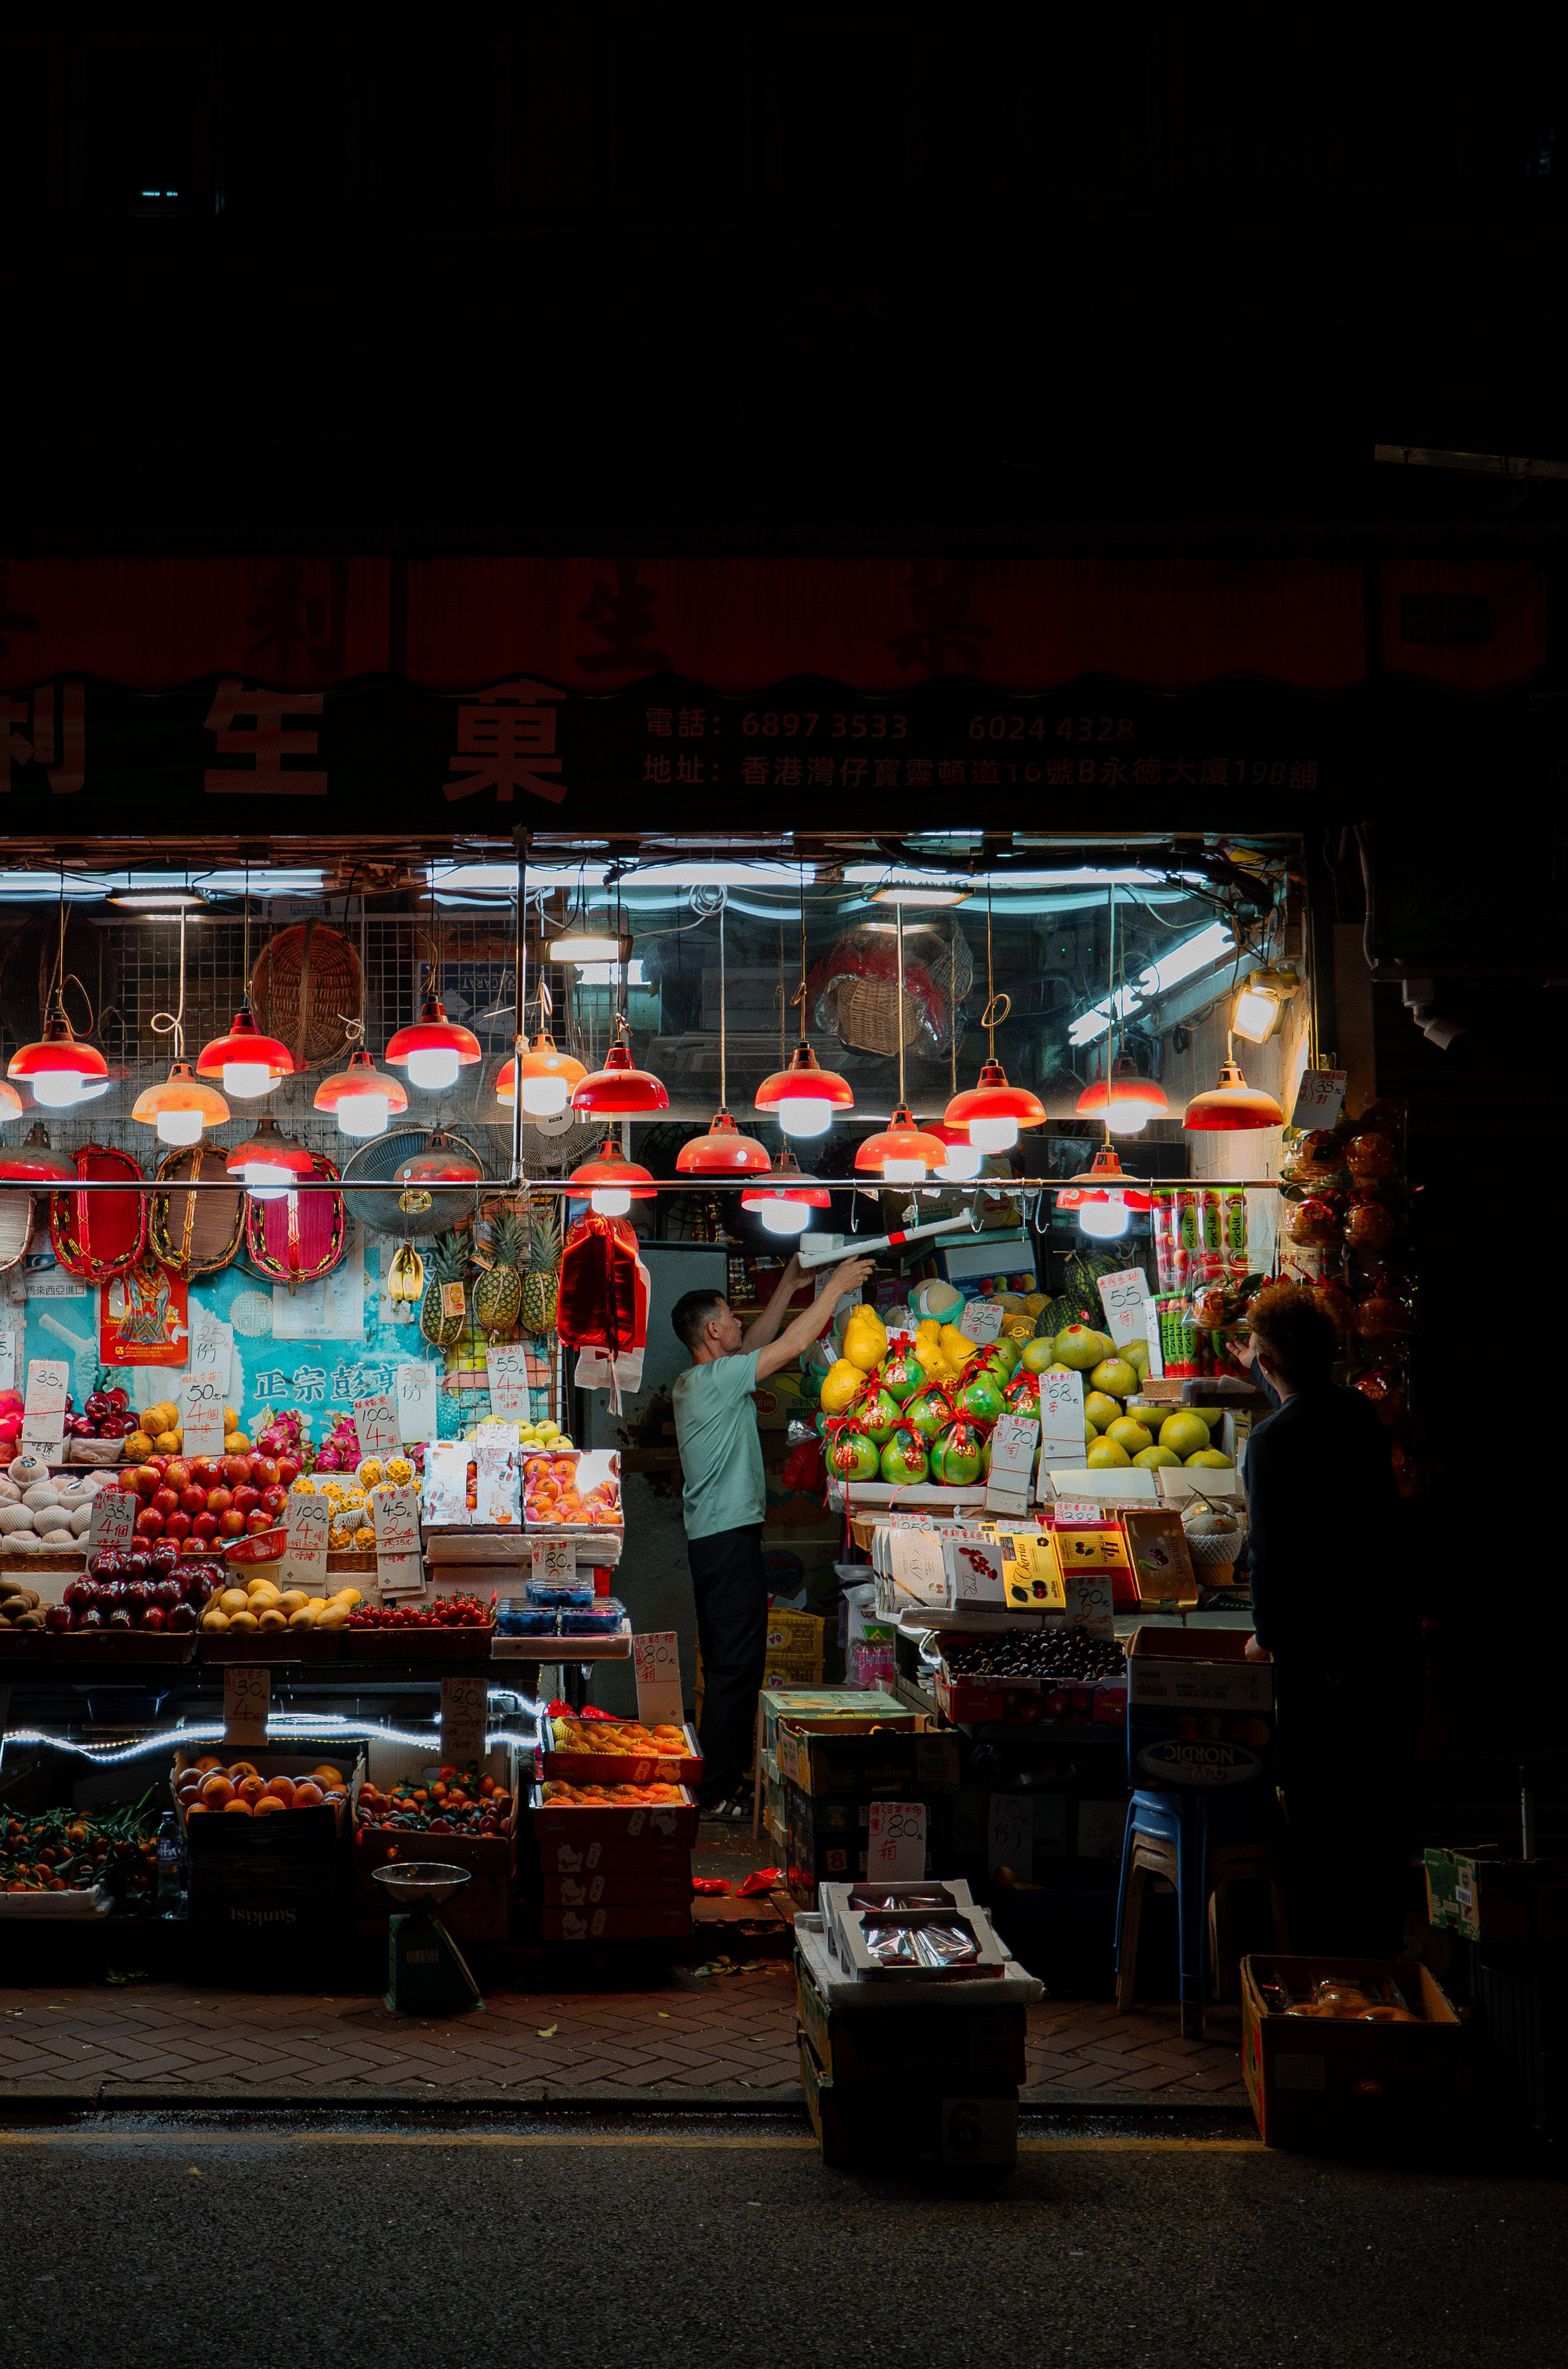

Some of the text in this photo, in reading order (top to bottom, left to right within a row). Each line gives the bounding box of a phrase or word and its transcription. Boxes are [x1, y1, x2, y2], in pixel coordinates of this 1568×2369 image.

[742, 711, 820, 738] 6897
[829, 713, 908, 739] 3533
[968, 715, 1046, 741] 6024
[1055, 717, 1135, 743] 4328
[462, 978, 499, 991] CARAT
[27, 1284, 84, 1296] 馬來西亞進口
[195, 1343, 217, 1364] 份
[495, 1355, 524, 1374] 55元
[36, 1370, 64, 1390] 35元
[402, 1367, 432, 1386] 30元
[187, 1384, 221, 1402] 50元
[402, 1384, 422, 1402] 份
[1049, 1383, 1079, 1404] 68元
[186, 1400, 219, 1422] 4個
[363, 1407, 395, 1422] 100元
[1011, 1428, 1034, 1450] 70元
[106, 1503, 132, 1521] 38元
[296, 1505, 328, 1524] 100元
[383, 1501, 412, 1518] 45元
[97, 1518, 129, 1537] 4個
[296, 1518, 325, 1543] 4個
[545, 1552, 572, 1572] 80元
[1013, 1543, 1032, 1582] Cherries
[1077, 1588, 1110, 1608] 90元
[644, 1645, 676, 1665] 80元
[234, 1679, 266, 1700] 30元
[451, 1687, 483, 1709] 20元
[1163, 1744, 1235, 1764] NORDIC
[887, 1815, 923, 1840] 80元
[230, 1907, 297, 1925] Sunkist
